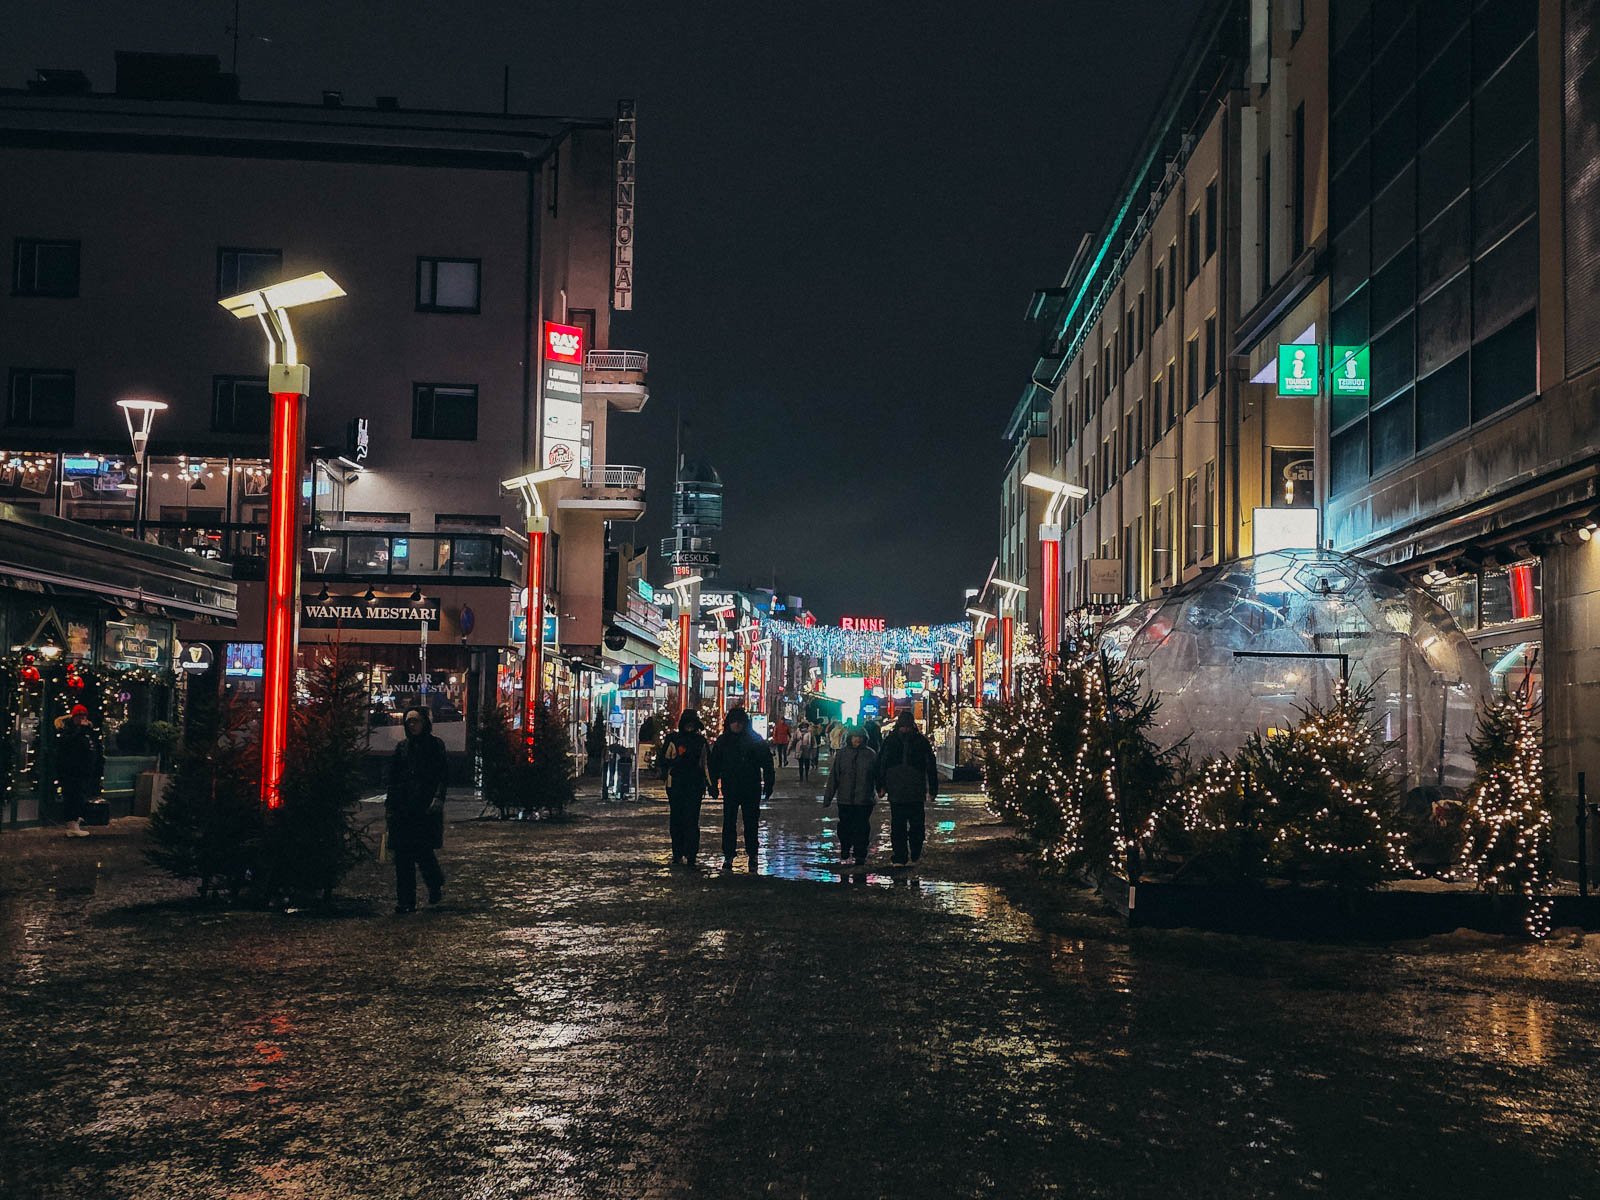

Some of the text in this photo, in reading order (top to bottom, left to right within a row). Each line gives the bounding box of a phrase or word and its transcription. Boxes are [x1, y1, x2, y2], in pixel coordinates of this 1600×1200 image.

[616, 99, 635, 308] RAVINTOLAT
[549, 332, 579, 350] RAX
[306, 606, 437, 620] WANHA MESTARI
[842, 617, 886, 632] RINNE
[408, 673, 432, 683] BAR
